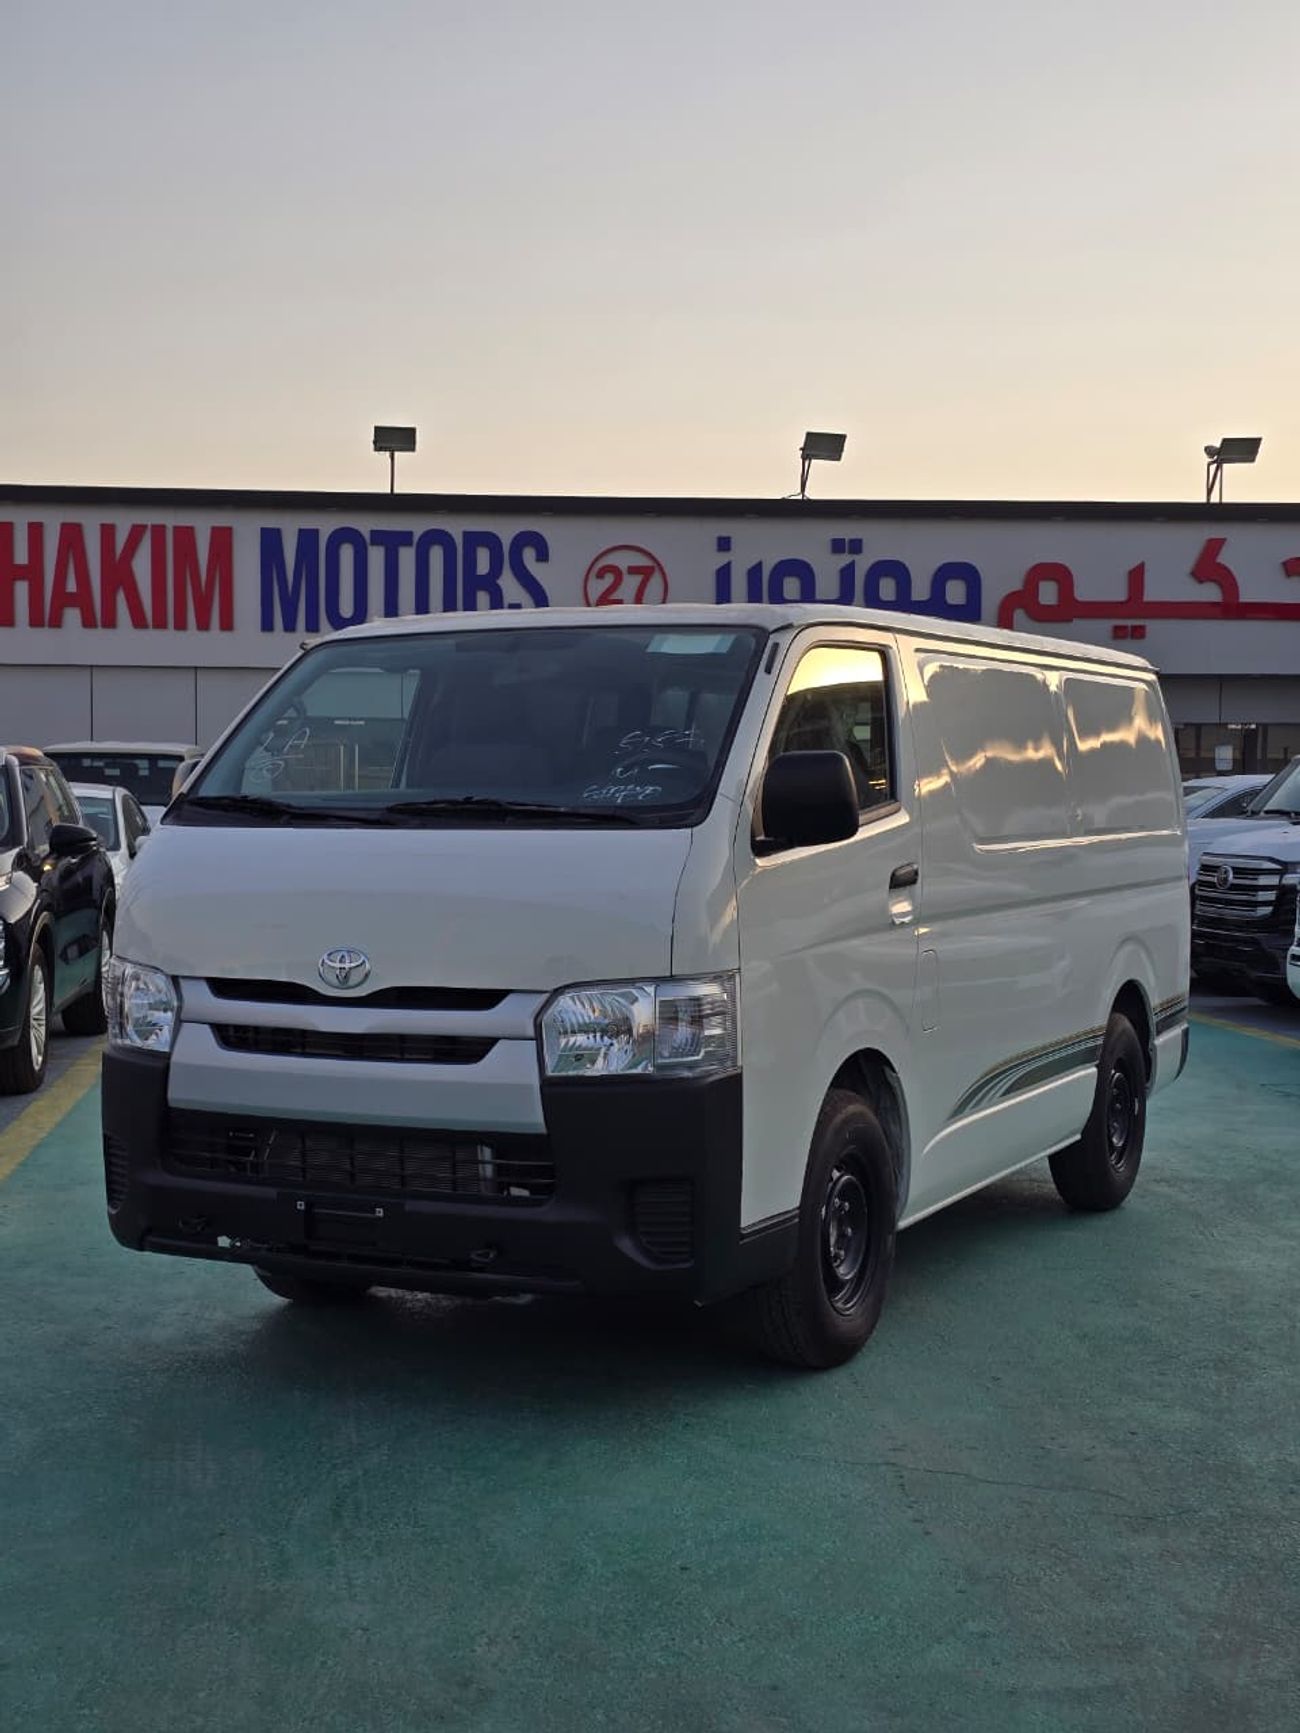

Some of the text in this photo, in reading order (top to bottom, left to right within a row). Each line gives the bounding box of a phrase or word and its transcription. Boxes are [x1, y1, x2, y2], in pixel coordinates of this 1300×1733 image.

[0, 521, 550, 632] HAKIM MOTORS
[595, 564, 656, 606] 27
[715, 536, 982, 621] موتورز
